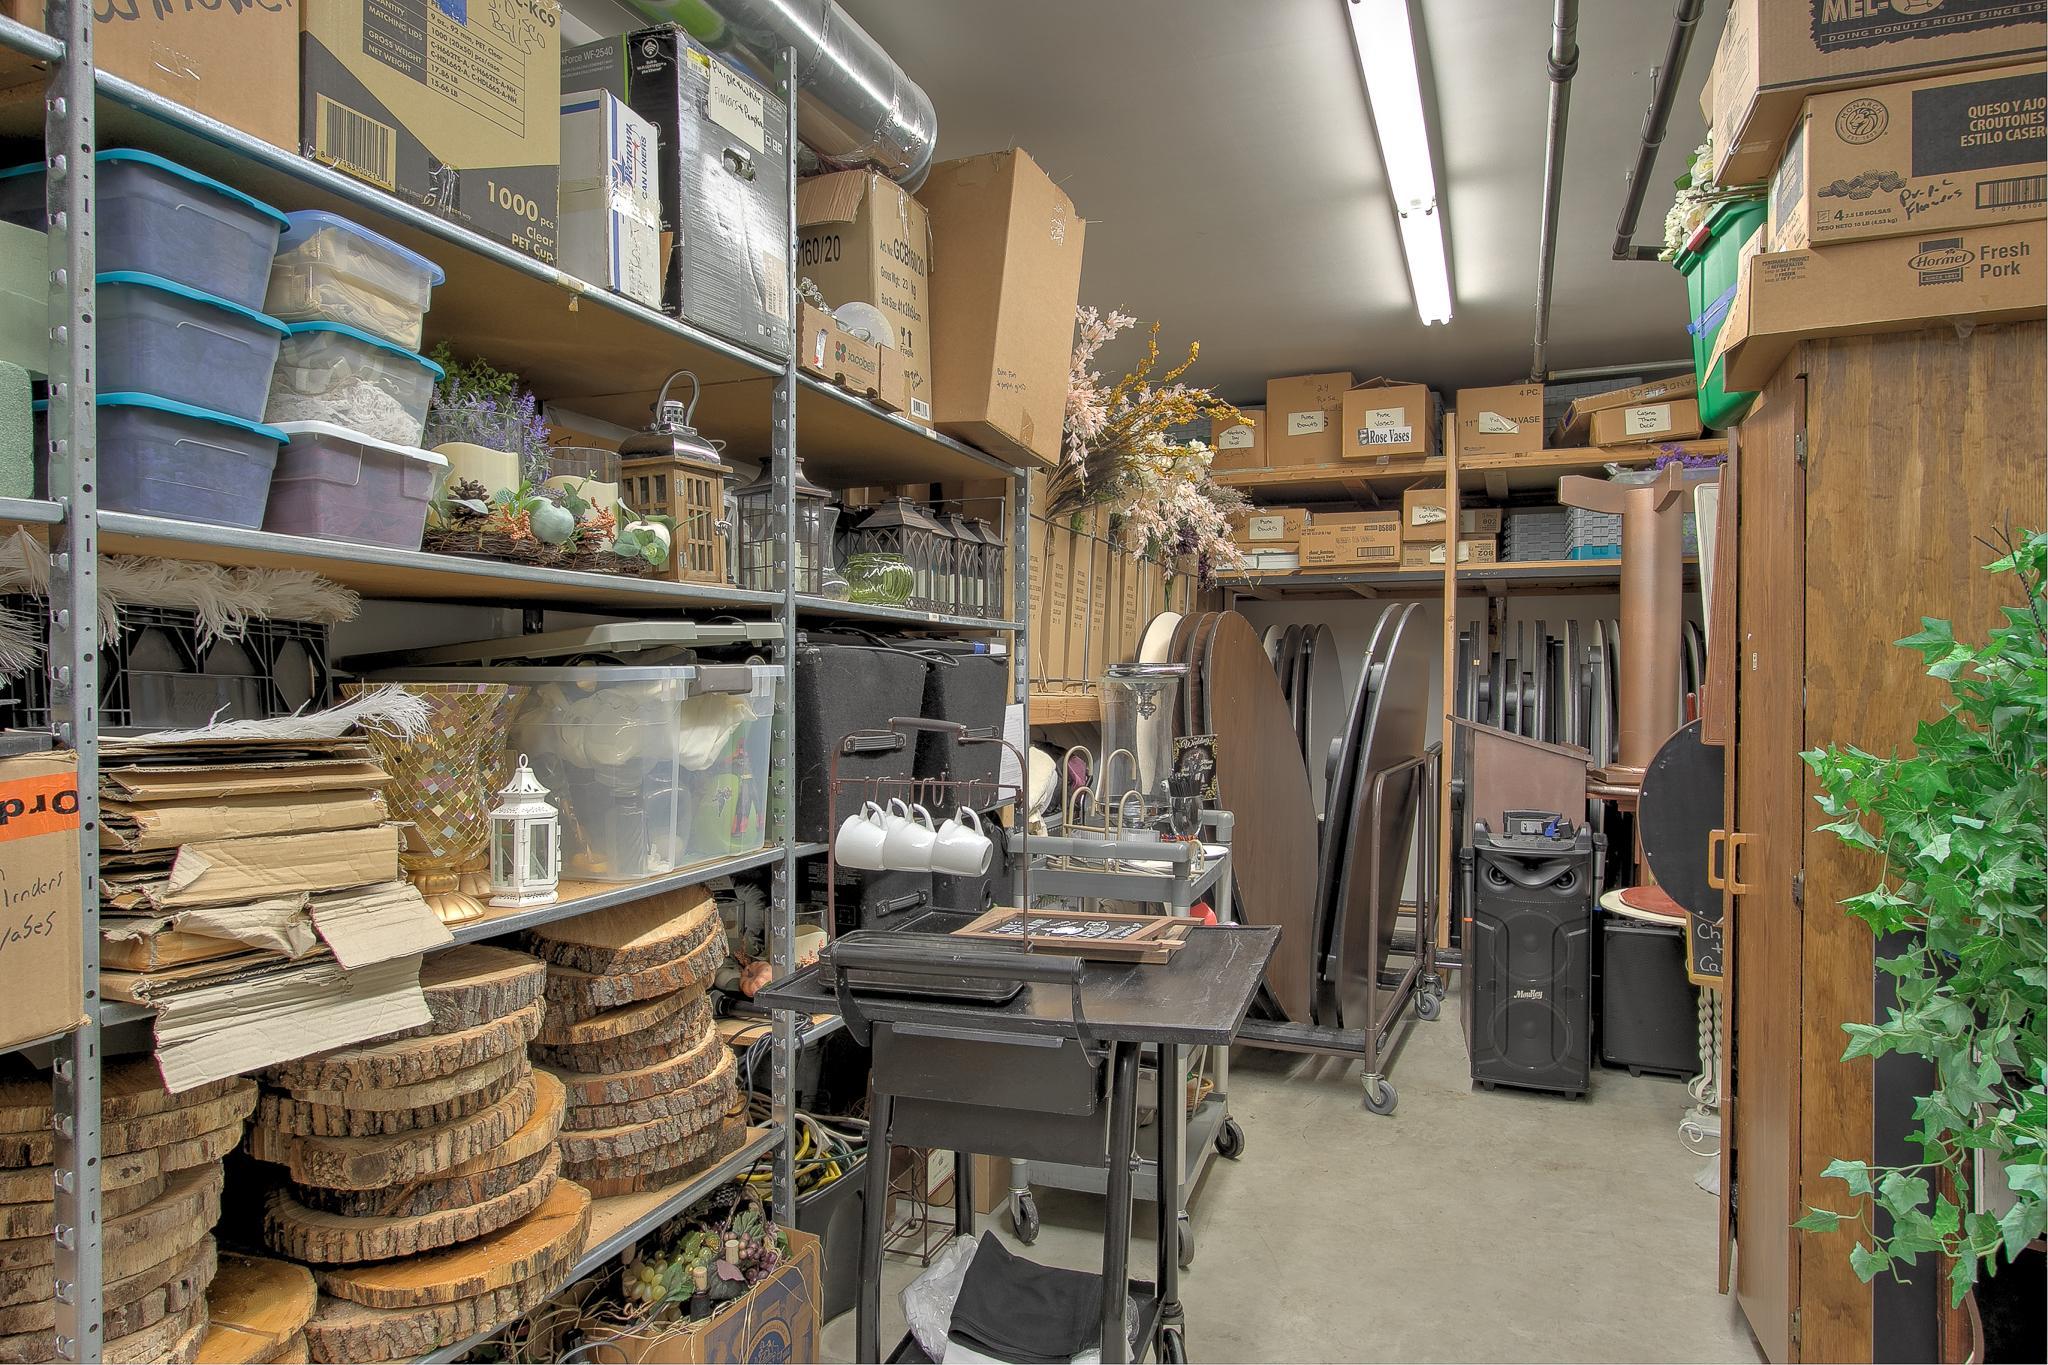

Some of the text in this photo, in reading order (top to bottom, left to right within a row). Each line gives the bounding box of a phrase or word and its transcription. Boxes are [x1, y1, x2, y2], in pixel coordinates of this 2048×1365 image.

[368, 5, 423, 41] MATCHING LIDS
[1828, 30, 1870, 42] DOING
[1874, 20, 1928, 34] DONUTS
[1933, 13, 1974, 26] RIGHT
[1979, 7, 2021, 20] SINCE
[431, 26, 448, 42] 1000
[368, 30, 422, 64] GROSS WEIGHT
[583, 46, 614, 61] WF-2540
[368, 44, 412, 73] NET WEIGHT
[1841, 101, 1884, 118] MONARCH
[1968, 97, 2046, 119] QUESO Y AJO
[1970, 111, 2045, 131] CROUTONES
[1960, 126, 2047, 147] ESTILO CASER
[640, 135, 648, 176] LINERS
[487, 180, 539, 222] 1000
[540, 217, 555, 229] pcs
[1834, 210, 1845, 221] 4
[1865, 207, 1892, 216] BOLSAS
[1835, 222, 1853, 230] NETO
[526, 226, 555, 247] Clear
[512, 232, 554, 264] PET Cup
[1980, 240, 2030, 261] Fresh
[1915, 252, 1967, 268] Hormel
[1980, 260, 2021, 279] Pork
[1518, 416, 1541, 424] VASE
[1370, 429, 1410, 443] Rose Vases
[1700, 955, 1724, 974] Ca
